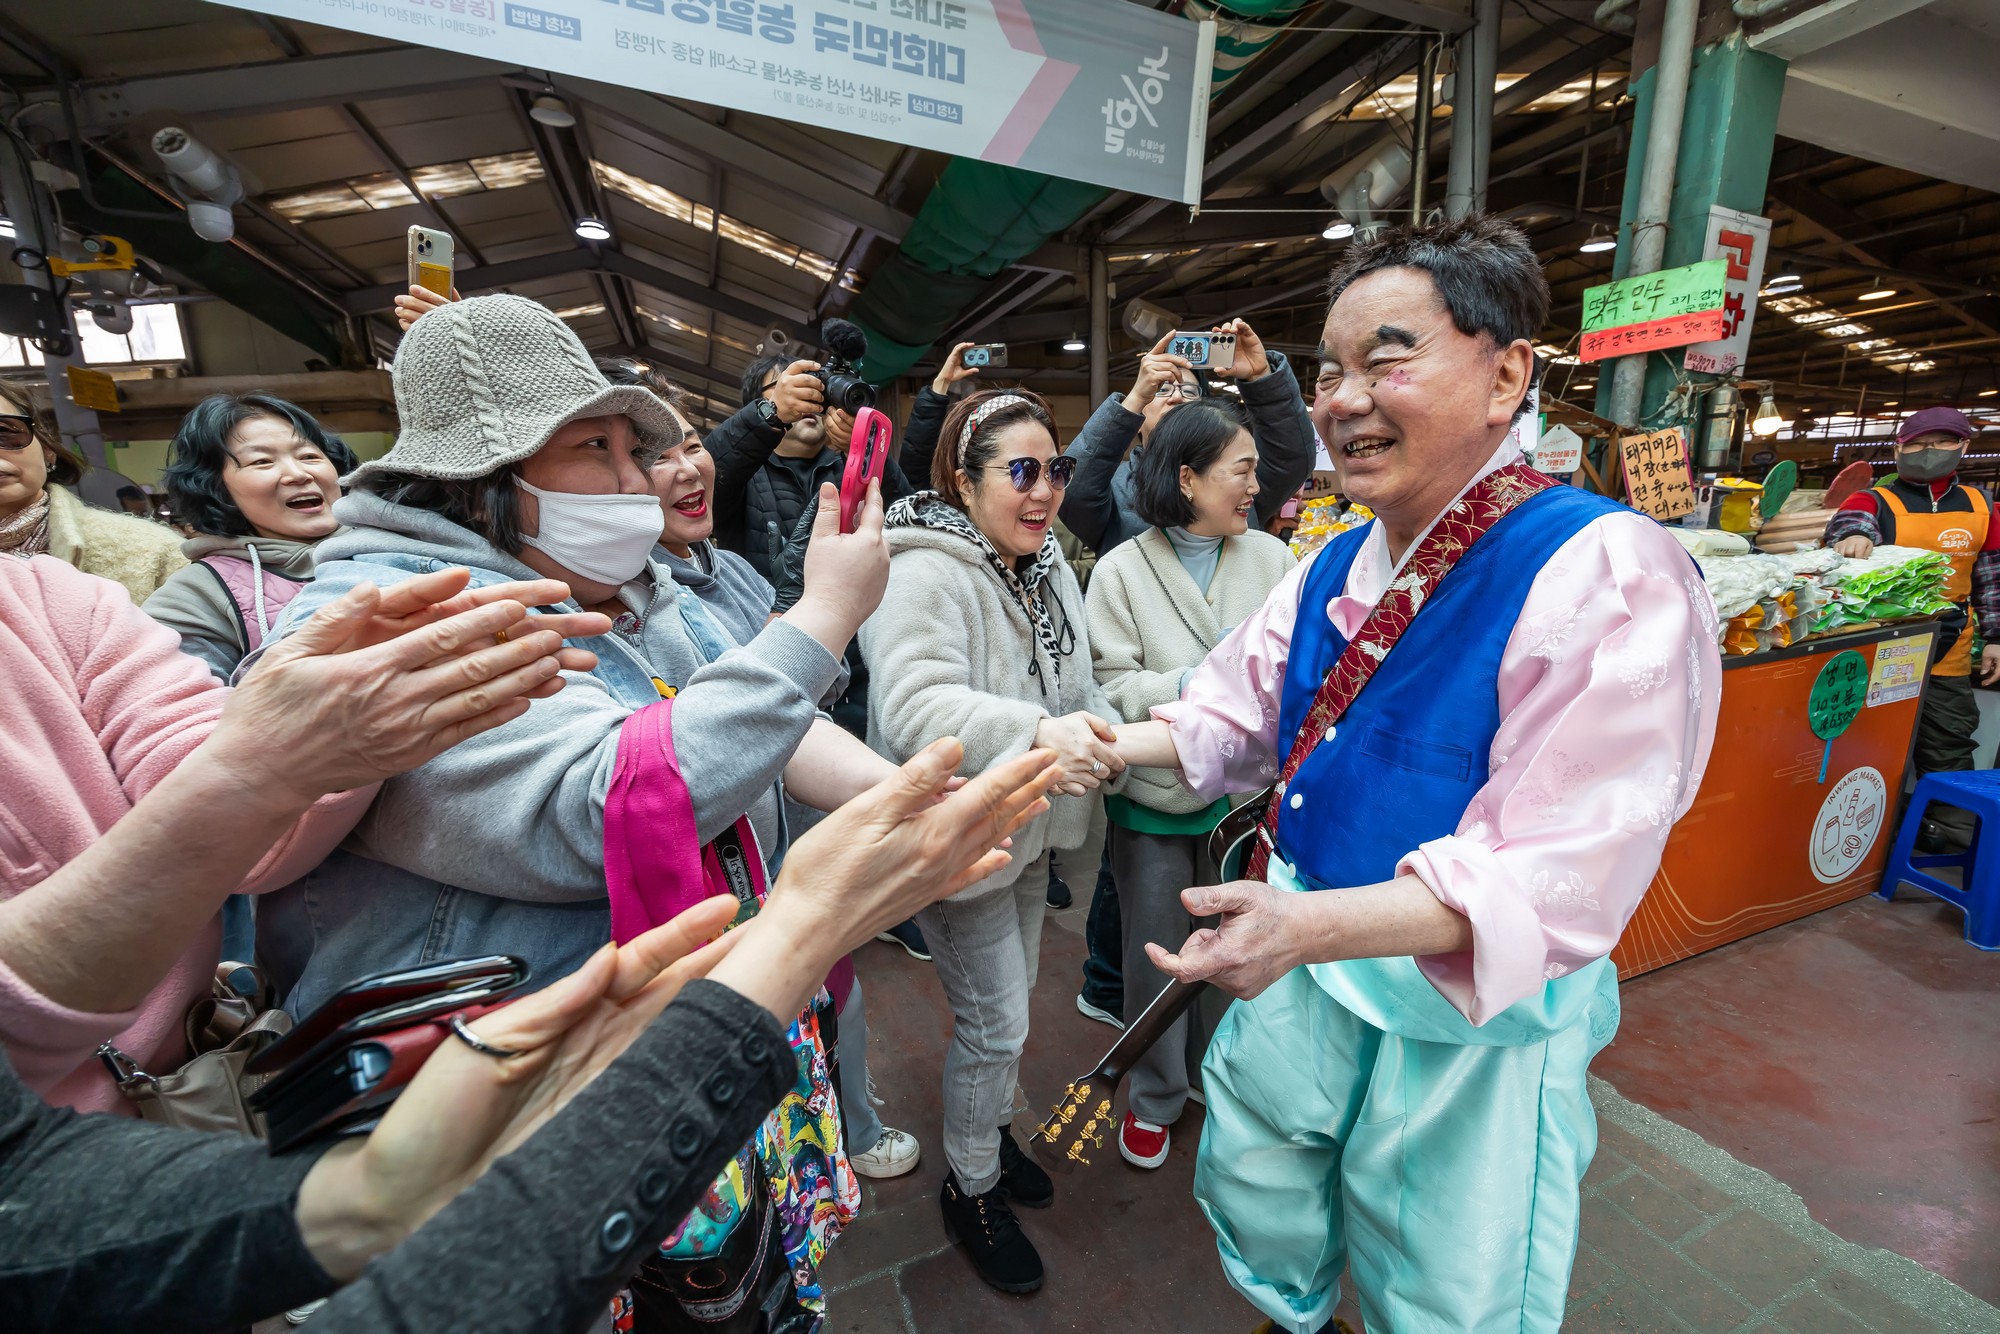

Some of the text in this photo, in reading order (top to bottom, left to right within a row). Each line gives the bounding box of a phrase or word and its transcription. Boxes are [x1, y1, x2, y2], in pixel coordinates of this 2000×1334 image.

[1632, 279, 1665, 312] 만두
[1626, 435, 1678, 463] 돼지머리
[1941, 540, 1970, 548] 코리아
[1827, 771, 1882, 805] INWANG MARKET
